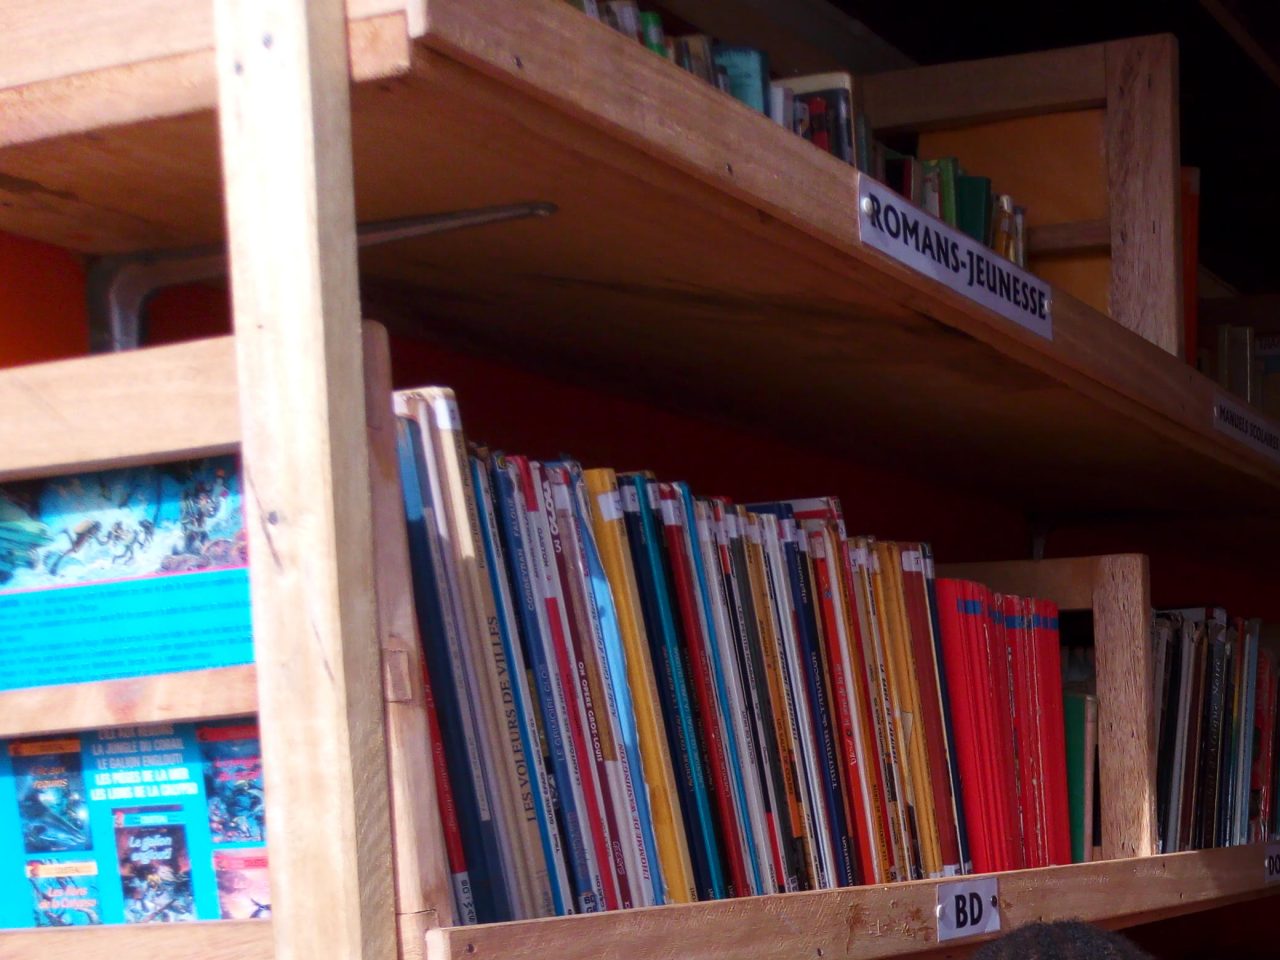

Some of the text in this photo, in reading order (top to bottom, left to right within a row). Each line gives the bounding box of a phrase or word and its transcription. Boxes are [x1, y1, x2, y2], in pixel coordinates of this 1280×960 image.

[869, 192, 1048, 320] ROMANS-JEUNESSE
[1219, 406, 1249, 435] MANUELS
[536, 527, 549, 567] GASTON
[515, 547, 535, 611] CORBEYRAN
[486, 614, 536, 822] LES VOLEURS DE VILLES
[545, 695, 562, 746] GRIMOIRE
[576, 661, 586, 677] ON
[585, 709, 603, 763] GROS-LOUIS
[91, 738, 185, 756] LA JUNGLE DU CORAIL
[98, 752, 183, 769] LE GALION ENGLOUTI
[556, 748, 565, 761] LE
[90, 788, 107, 801] LES
[135, 785, 147, 797] DE
[147, 784, 160, 796] LA
[95, 773, 112, 786] LES
[141, 771, 154, 782] DE
[155, 769, 167, 781] LA
[168, 767, 189, 780] MER
[616, 742, 650, 881] L'HOMME DE WASHINGTON
[129, 835, 172, 851] Le galion
[132, 849, 171, 864] englouti
[594, 874, 605, 907] GRATON
[955, 892, 983, 929] BD
